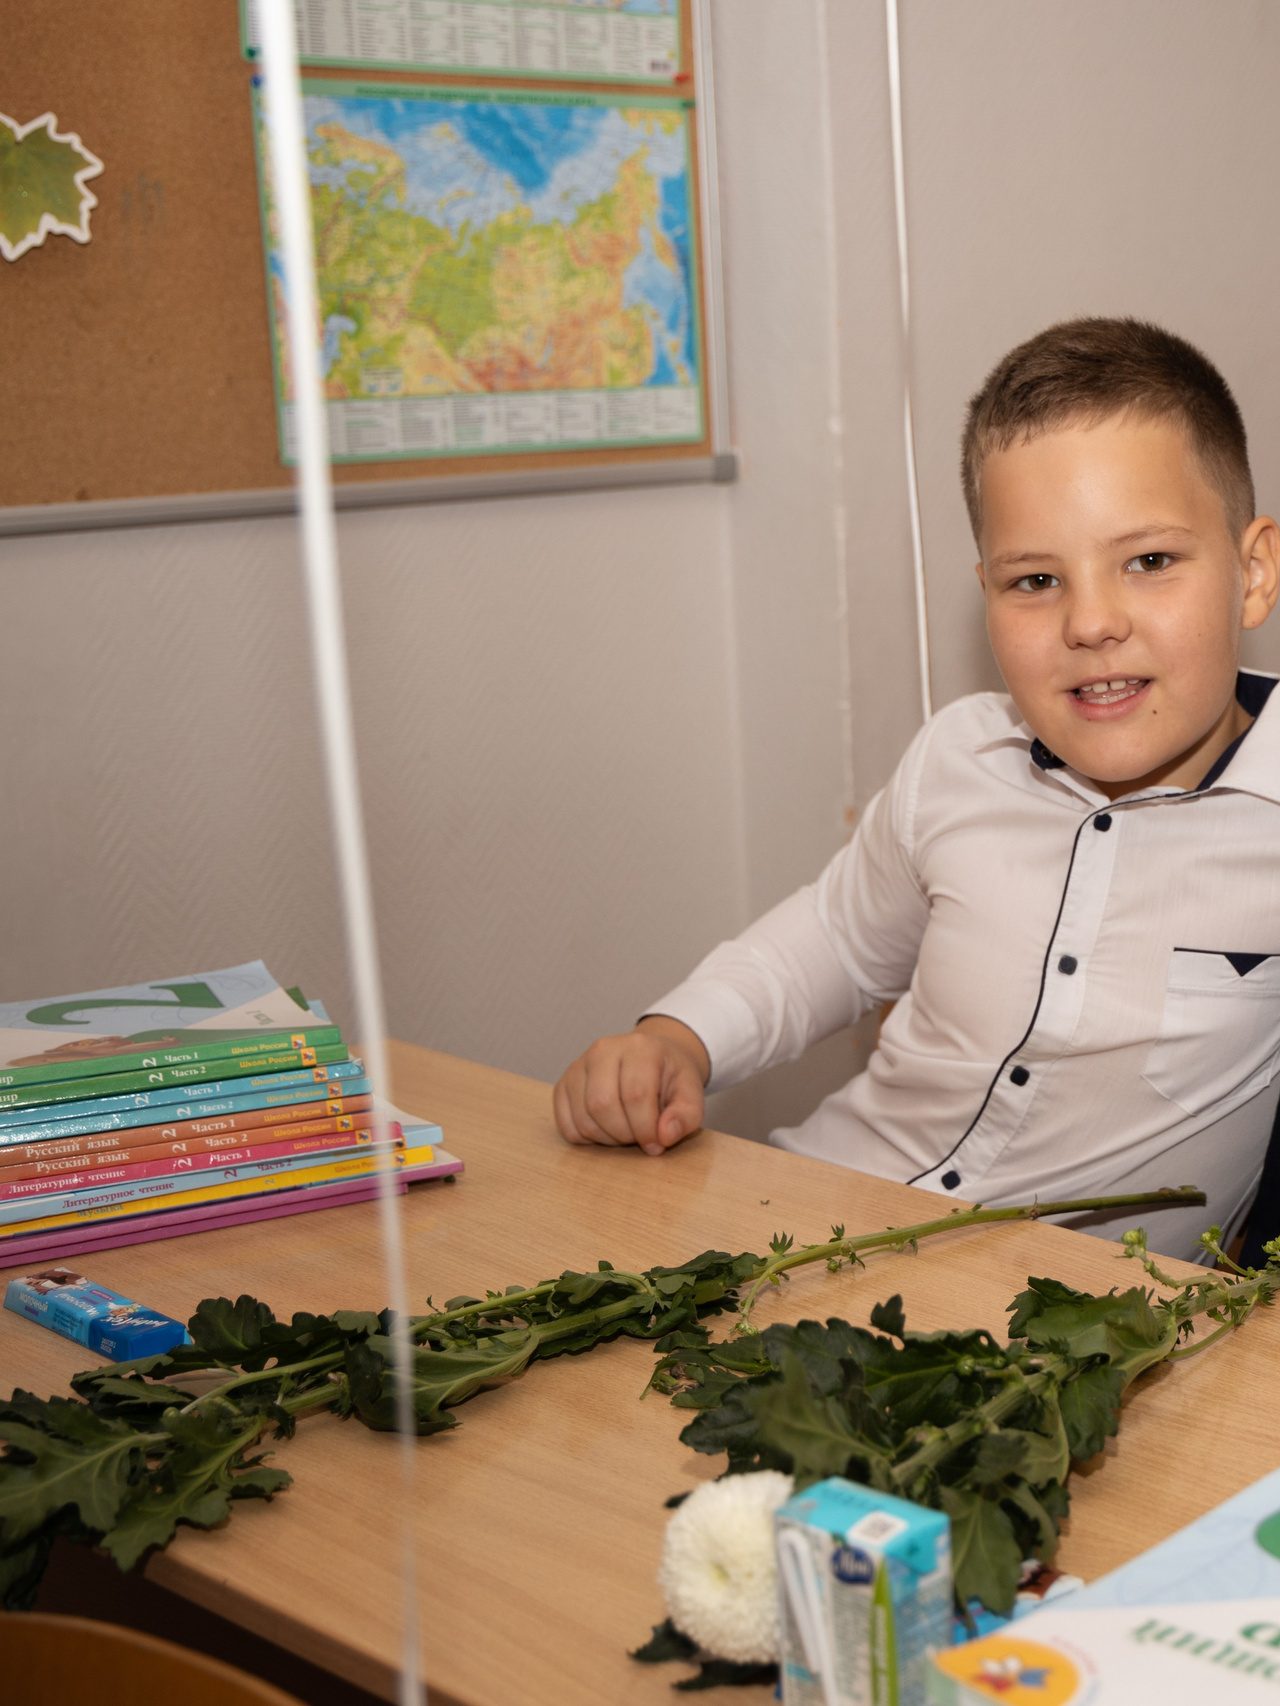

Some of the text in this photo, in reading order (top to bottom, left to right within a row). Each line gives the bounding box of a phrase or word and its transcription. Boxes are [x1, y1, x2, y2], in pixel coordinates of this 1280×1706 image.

[26, 982, 225, 1025] 2
[142, 1057, 157, 1068] 2
[164, 1053, 190, 1063] Часть
[194, 1052, 199, 1060] 1
[231, 1046, 258, 1055] Школа
[260, 1042, 288, 1051] России
[149, 1072, 164, 1083] 2
[171, 1068, 199, 1078] Часть
[239, 1060, 267, 1069] Школа
[268, 1055, 298, 1064] России
[135, 1073, 309, 1106] 2 Часть 1 Школа России
[177, 1089, 324, 1117] 2 Часть 2 Школа России
[26, 1108, 322, 1159] Русский язык 2 Часть 1 Школа России
[36, 1123, 332, 1173] Русский язык 2 Часть 2 Школа России
[8, 1175, 85, 1194] Литературное
[88, 1170, 126, 1182] чтение
[177, 1158, 192, 1168] 2
[212, 1152, 243, 1163] Часть
[293, 1141, 321, 1150] Школа
[322, 1135, 351, 1145] России
[62, 1158, 293, 1209] Литературное чтение 2 Часть 2
